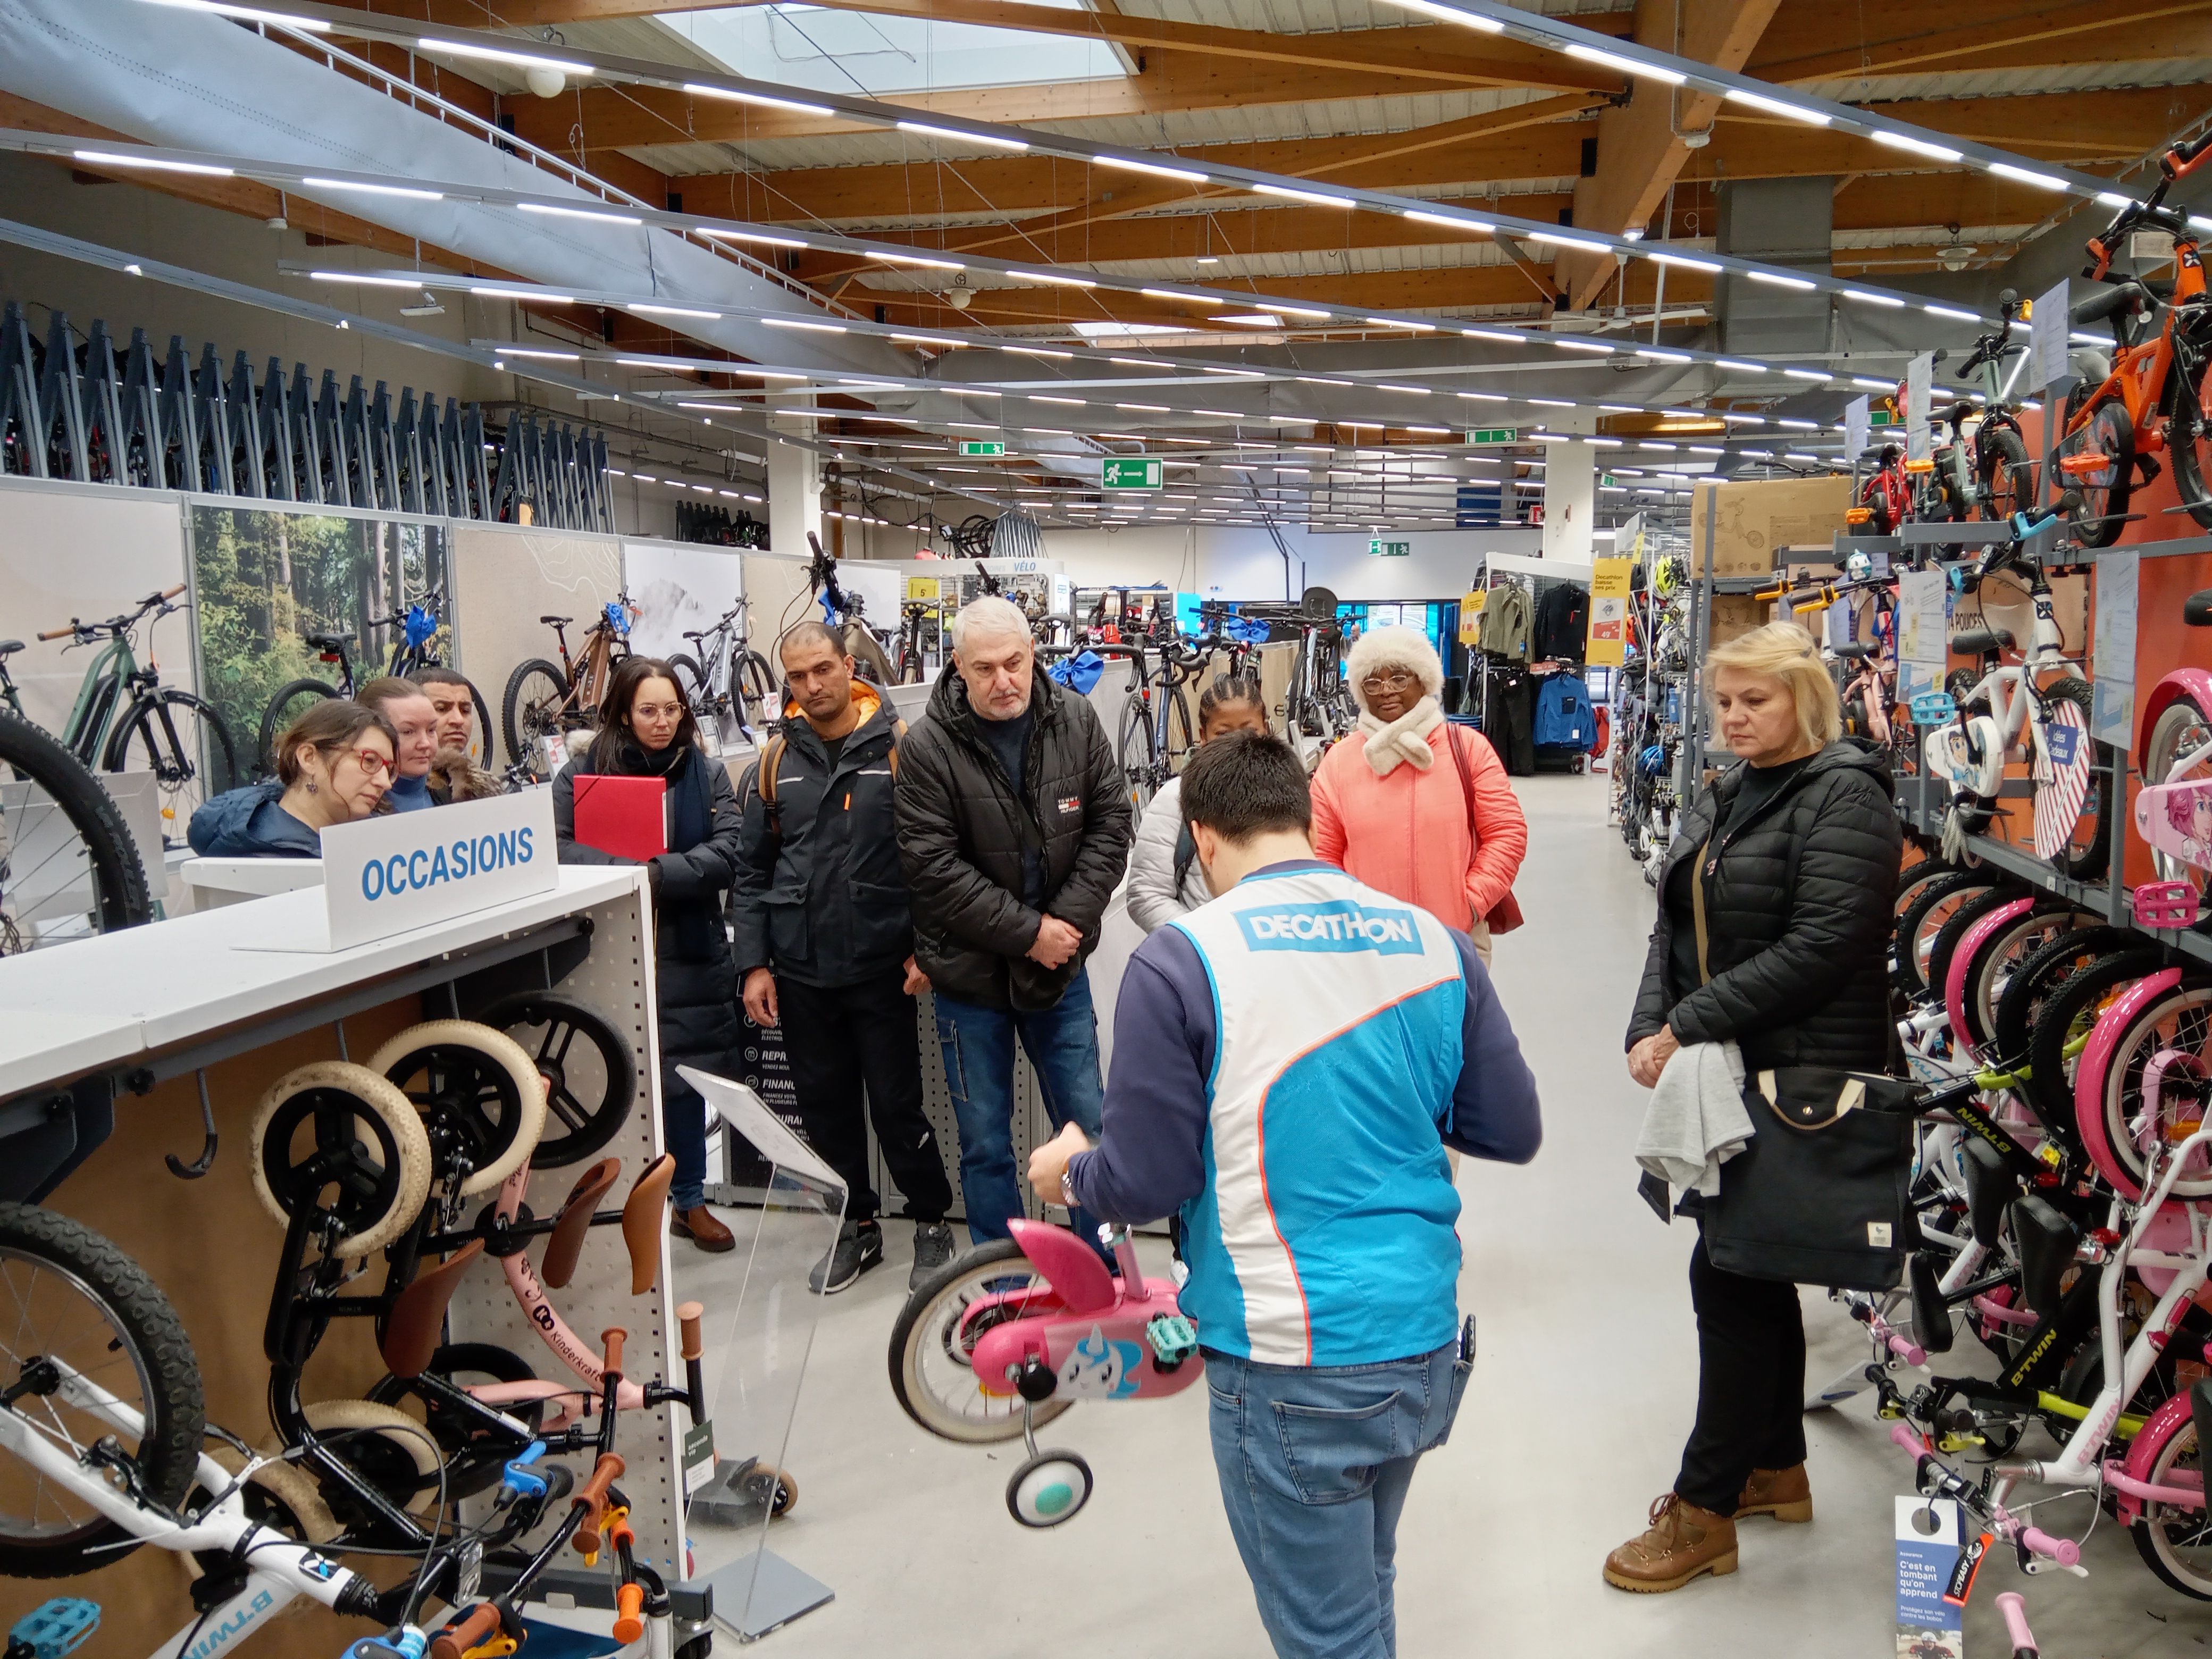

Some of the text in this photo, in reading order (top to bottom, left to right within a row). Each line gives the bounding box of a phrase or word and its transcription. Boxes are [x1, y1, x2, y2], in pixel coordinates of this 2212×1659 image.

[1014, 560, 1036, 572] VÉLO
[1058, 795, 1078, 804] TOMMY
[362, 827, 533, 901] OCCASIONS
[1248, 911, 1414, 944] DECATHON
[762, 1050, 788, 1062] REPR
[551, 1329, 601, 1382] Kinderkraft
[688, 1435, 708, 1451] seconde
[688, 1448, 697, 1457] vie
[1900, 1560, 1922, 1571] C'est
[1900, 1569, 1938, 1582] tombant
[1900, 1579, 1925, 1589] qu'on
[1900, 1587, 1938, 1599] apprend
[1900, 1604, 1923, 1614] Protégez
